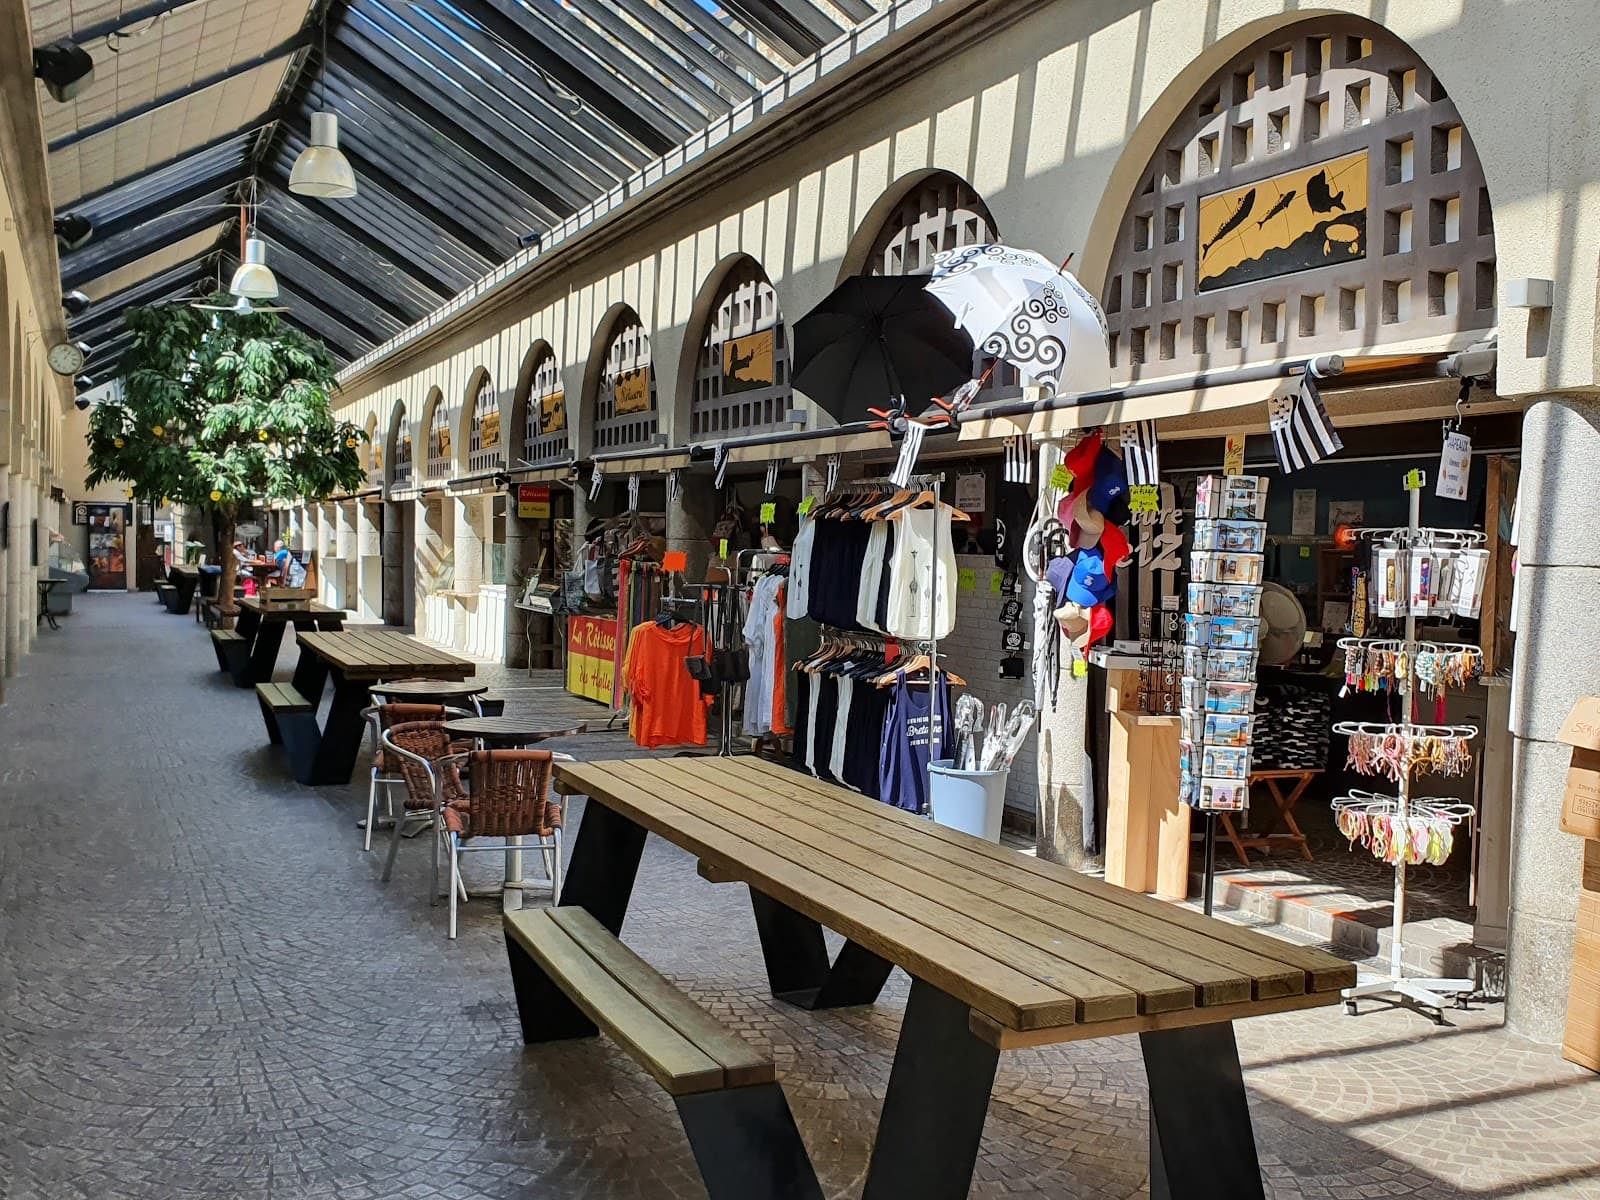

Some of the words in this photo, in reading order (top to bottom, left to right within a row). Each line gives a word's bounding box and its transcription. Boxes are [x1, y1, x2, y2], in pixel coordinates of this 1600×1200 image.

[1124, 508, 1183, 526] ture
[571, 619, 583, 646] La
[906, 725, 942, 737] Bretane
